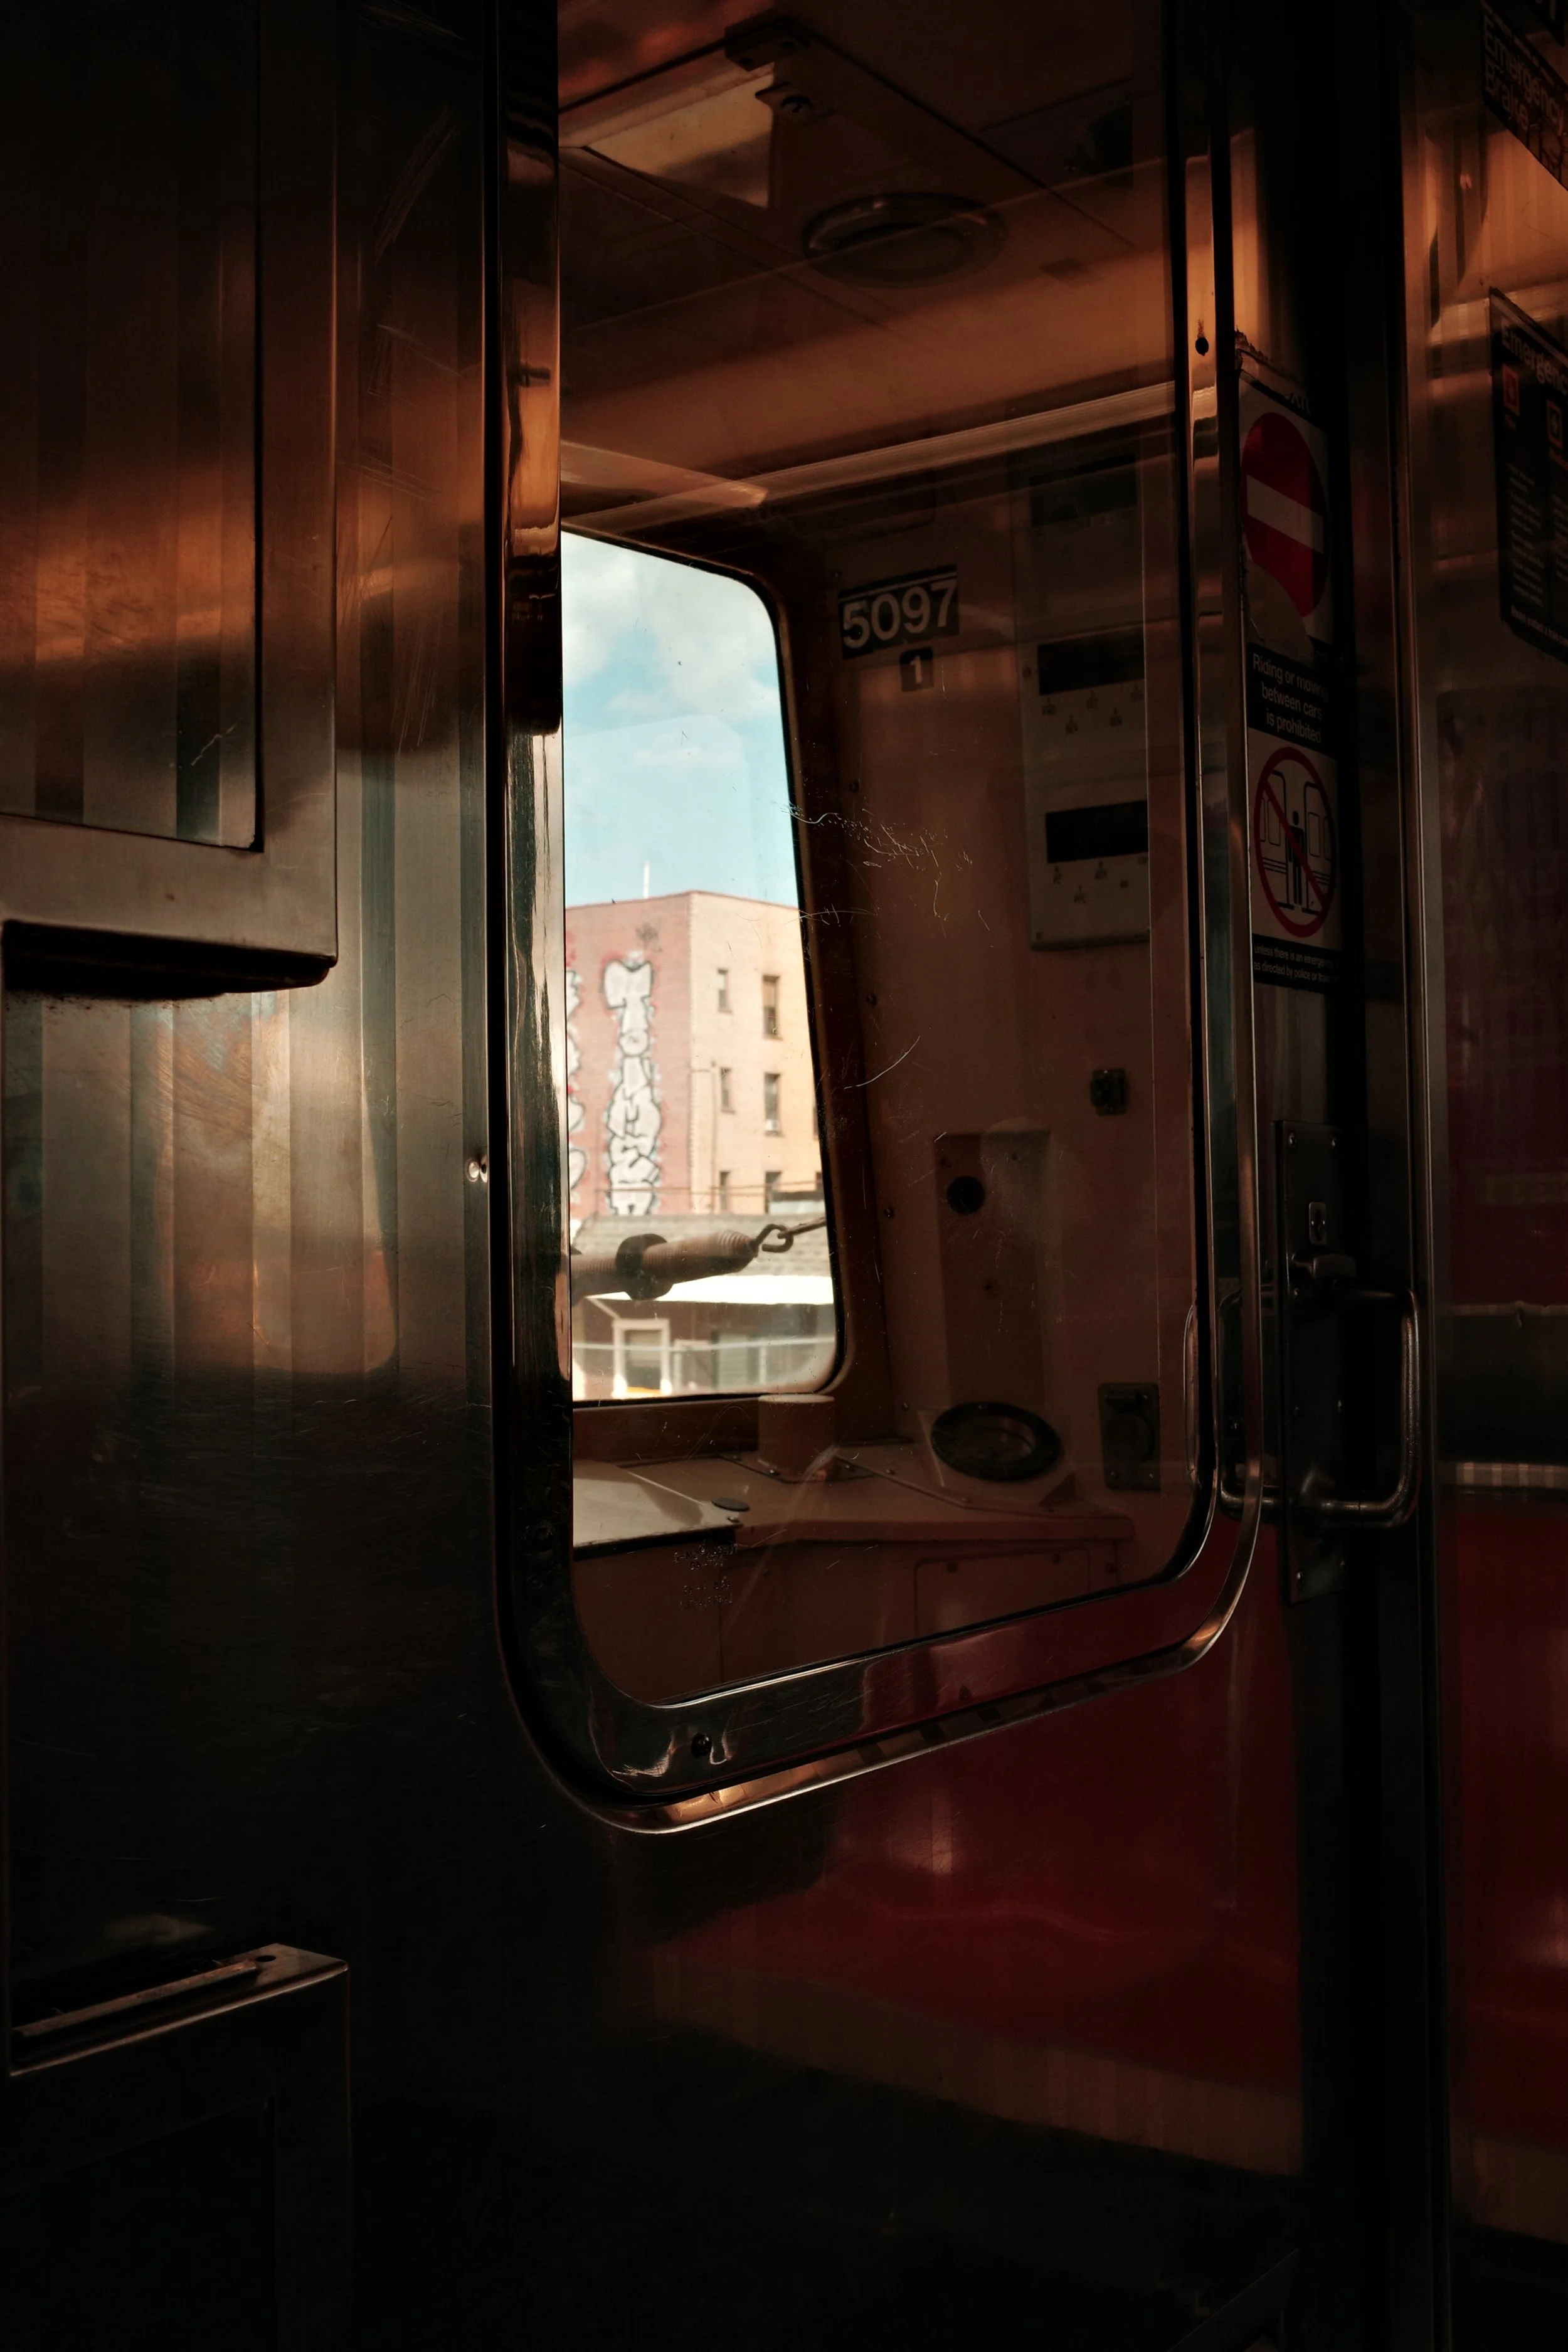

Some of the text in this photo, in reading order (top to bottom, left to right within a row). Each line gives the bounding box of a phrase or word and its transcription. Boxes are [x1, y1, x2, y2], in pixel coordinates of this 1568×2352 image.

[1483, 14, 1564, 137] Emergency
[1483, 53, 1529, 132] Brake
[842, 579, 957, 648] 5097
[909, 654, 923, 684] 1
[1253, 652, 1330, 704] Riding or moving
[1261, 681, 1323, 721] between cars
[1266, 707, 1322, 743] is prohibited
[1253, 961, 1261, 970] as
[1261, 960, 1285, 975] directed
[1286, 965, 1293, 978] by
[1293, 968, 1311, 980] police
[1311, 973, 1318, 982] or
[1254, 943, 1273, 957] unless
[1274, 947, 1289, 960] there
[1290, 950, 1295, 961] is
[1296, 954, 1303, 962] an
